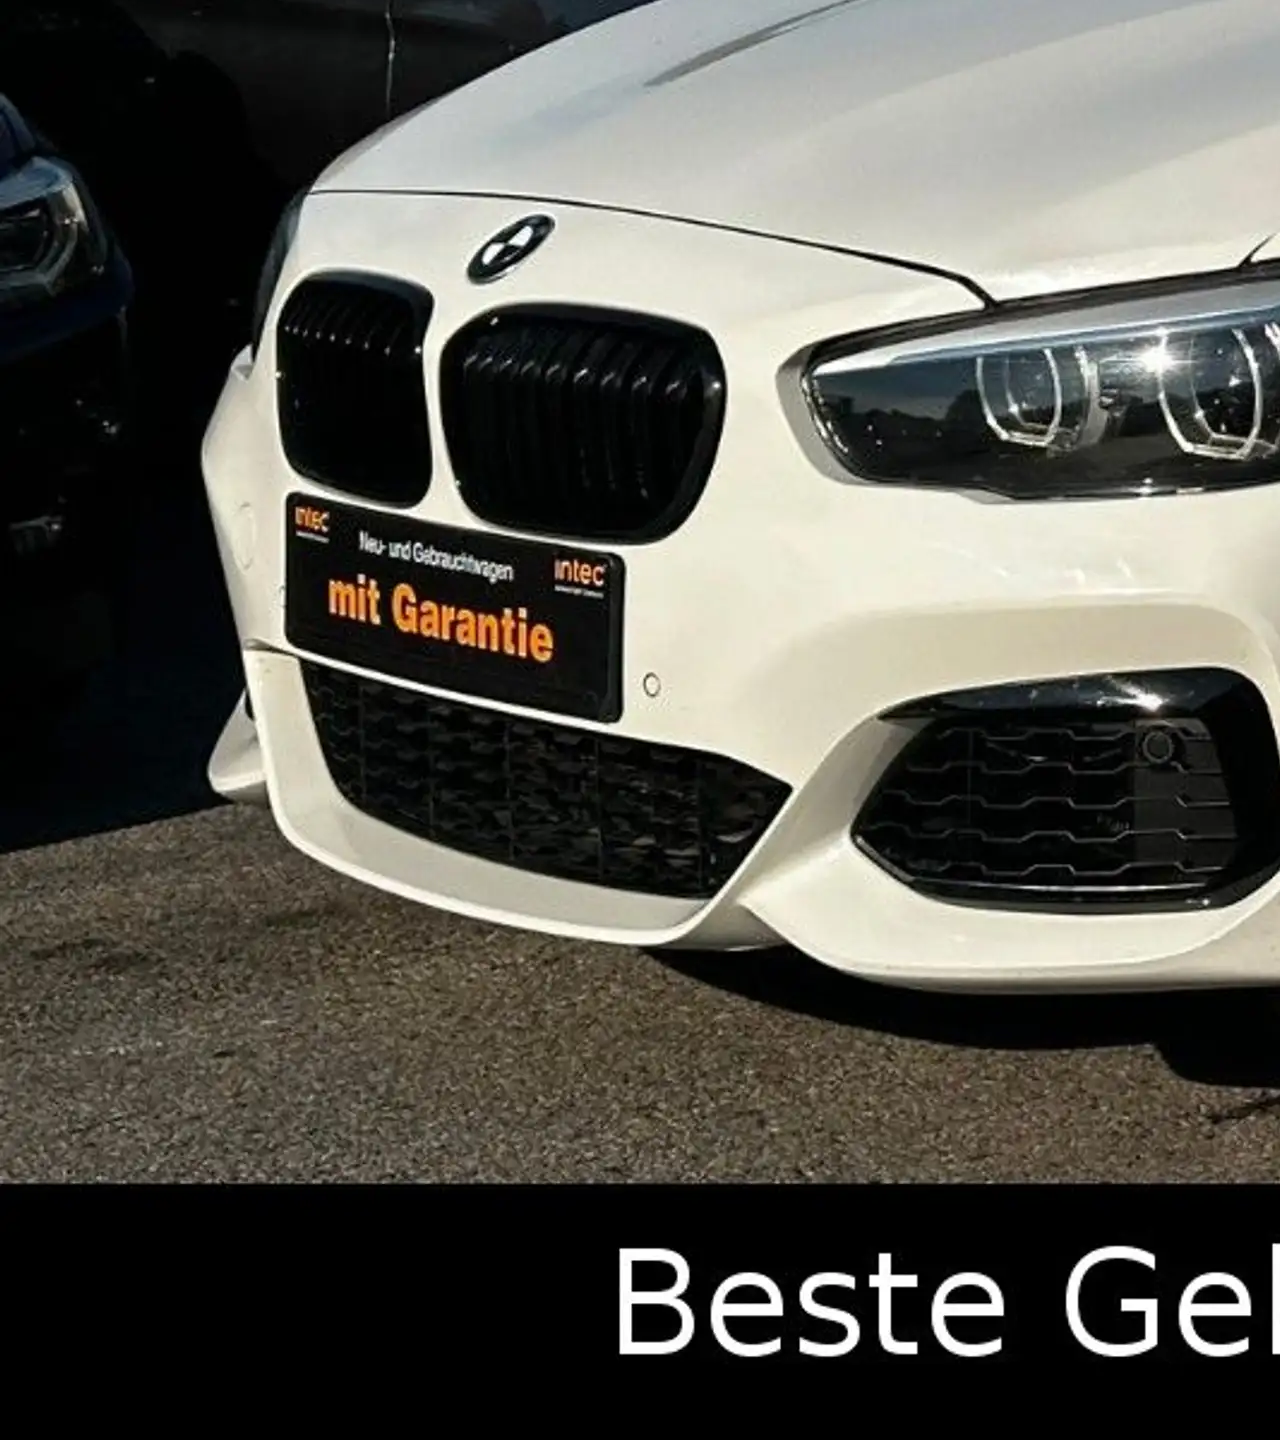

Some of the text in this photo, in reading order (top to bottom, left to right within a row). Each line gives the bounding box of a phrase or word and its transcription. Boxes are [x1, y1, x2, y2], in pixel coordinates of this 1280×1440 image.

[358, 530, 387, 556] Neu-
[389, 539, 412, 562] und
[412, 541, 515, 585] Gebrauchtwagen
[553, 557, 606, 587] intec
[328, 573, 555, 662] mit Garantie
